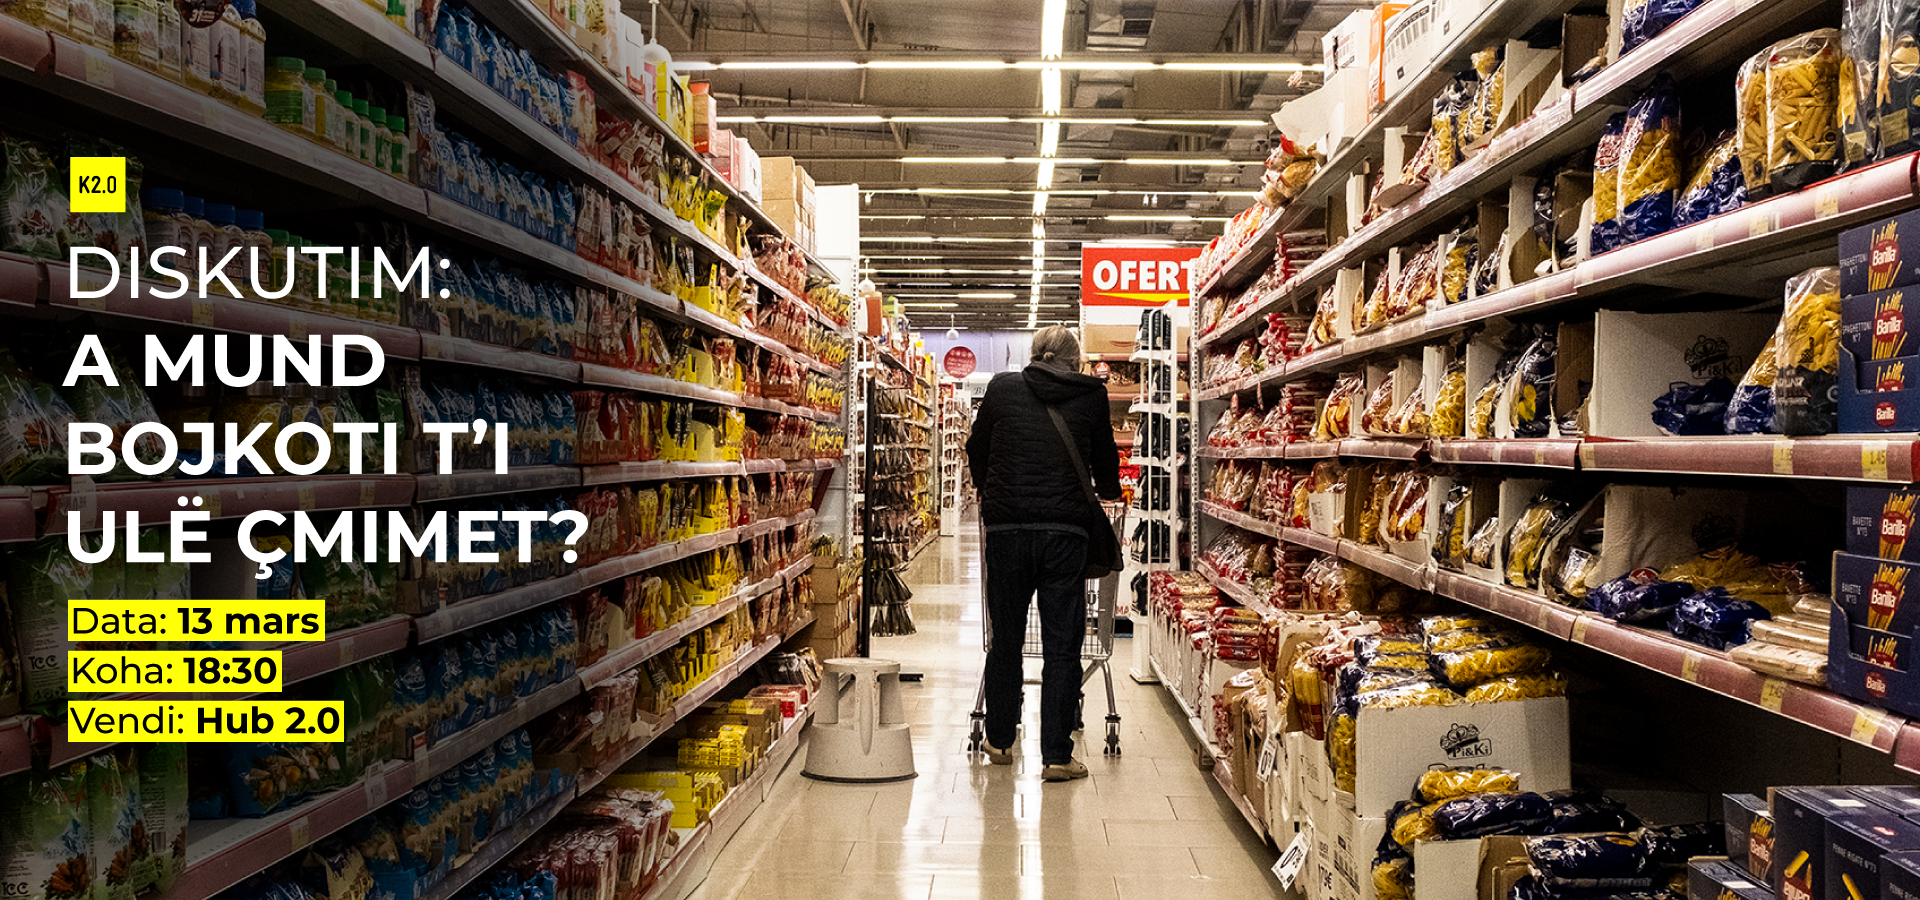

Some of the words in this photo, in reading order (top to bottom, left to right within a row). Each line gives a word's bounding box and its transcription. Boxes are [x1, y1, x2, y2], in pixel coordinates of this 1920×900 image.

[1876, 316, 1901, 336] Barilla
[1876, 407, 1895, 420] Barilla
[1882, 518, 1906, 536] Barilla
[1871, 588, 1896, 608] Barilla
[1866, 676, 1886, 693] Barilla
[1452, 742, 1489, 758] Pi&Ki
